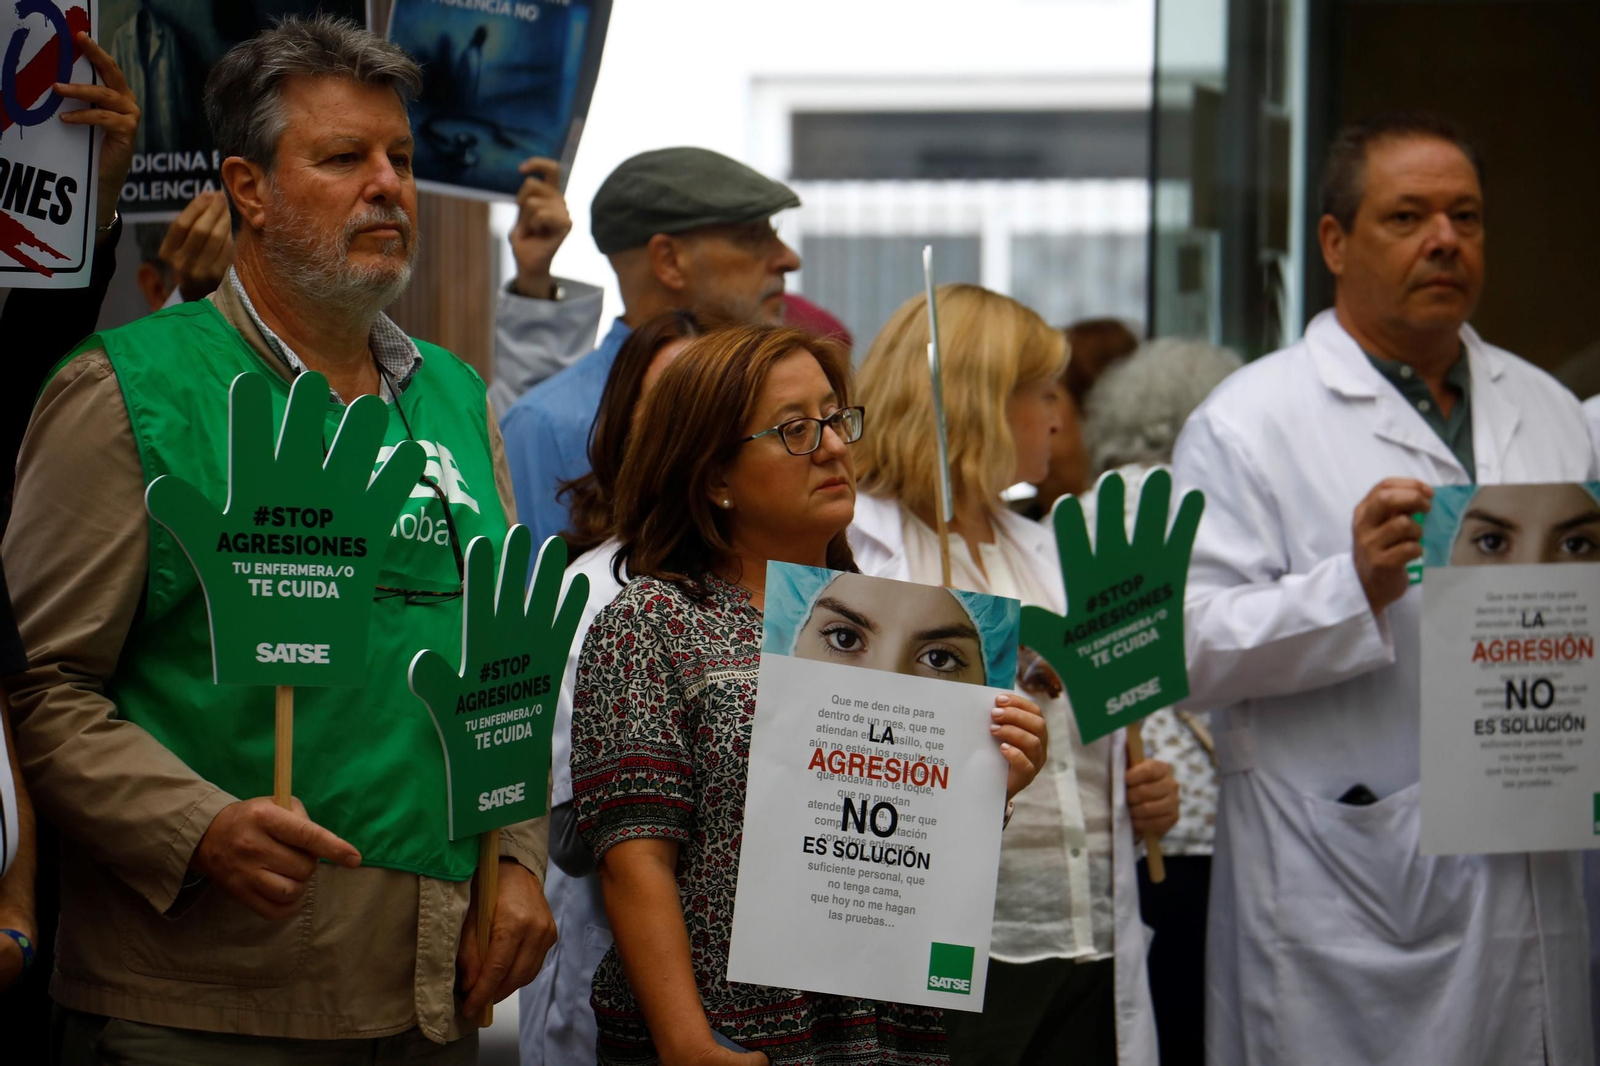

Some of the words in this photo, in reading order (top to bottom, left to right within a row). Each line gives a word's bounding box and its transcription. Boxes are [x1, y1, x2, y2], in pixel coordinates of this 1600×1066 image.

[514, 4, 540, 21] NO
[128, 151, 207, 173] DICINA
[119, 178, 216, 202] OLENCIA
[253, 506, 334, 528] #STOP
[216, 532, 368, 557] AGRESIONES
[232, 562, 251, 574] TU
[254, 563, 355, 577] ENFERMERA/O
[248, 579, 273, 597] TE
[277, 580, 340, 599] CUIDA
[1088, 574, 1143, 611] #STOP
[1065, 584, 1172, 644] AGRESIONES
[1521, 610, 1544, 629] LA
[255, 642, 330, 664] SATSE
[1077, 645, 1092, 657] TU
[1090, 650, 1110, 668] TE
[1113, 629, 1158, 656] CUIDA
[1471, 632, 1594, 663] AGRESIÓN
[480, 653, 531, 683] #STOP
[455, 675, 551, 716] AGRESIONES
[831, 694, 851, 706] Que
[854, 700, 869, 709] me
[871, 701, 890, 712] den
[893, 705, 910, 715] cita
[912, 708, 935, 719] para
[1106, 678, 1160, 714] SATSE
[1505, 677, 1555, 711] NO
[465, 720, 478, 732] TU
[479, 704, 543, 730] ENFERMERA/O
[818, 708, 850, 721] dentro
[853, 713, 865, 724] de
[909, 723, 927, 734] que
[930, 726, 945, 735] me
[1474, 719, 1495, 736] ES
[1500, 712, 1586, 735] SOLUCIÓN
[475, 731, 491, 750] TE
[493, 722, 533, 745] CUIDA
[816, 724, 858, 738] atiendan
[887, 734, 922, 748] asillo,
[925, 741, 944, 753] que
[869, 723, 895, 745] LA
[809, 738, 828, 749] aún
[831, 741, 843, 751] no
[846, 743, 872, 756] estén
[875, 747, 890, 757] los
[808, 747, 949, 790] AGRESIÓN
[816, 770, 835, 781] que
[876, 779, 888, 788] no
[891, 780, 901, 790] te
[478, 782, 526, 812] SATSE
[837, 789, 856, 800] que
[858, 790, 871, 800] no
[873, 794, 911, 807] puedan
[808, 800, 843, 812] atende
[893, 813, 916, 823] ener
[918, 816, 937, 827] que
[841, 797, 899, 838] NO
[803, 836, 827, 856] ES
[833, 840, 931, 870] SOLUCIÓN
[807, 861, 856, 876] suficiente
[858, 868, 904, 884] personal,
[906, 875, 925, 886] que
[828, 879, 840, 889] no
[843, 881, 870, 894] tenga
[873, 885, 902, 899] cama,
[811, 892, 829, 904] que
[832, 894, 850, 907] hoy
[853, 899, 865, 908] no
[868, 901, 883, 910] me
[885, 902, 916, 915] hagan
[828, 909, 842, 920] las
[845, 911, 895, 928] pruebas...
[928, 975, 970, 991] SATSE
